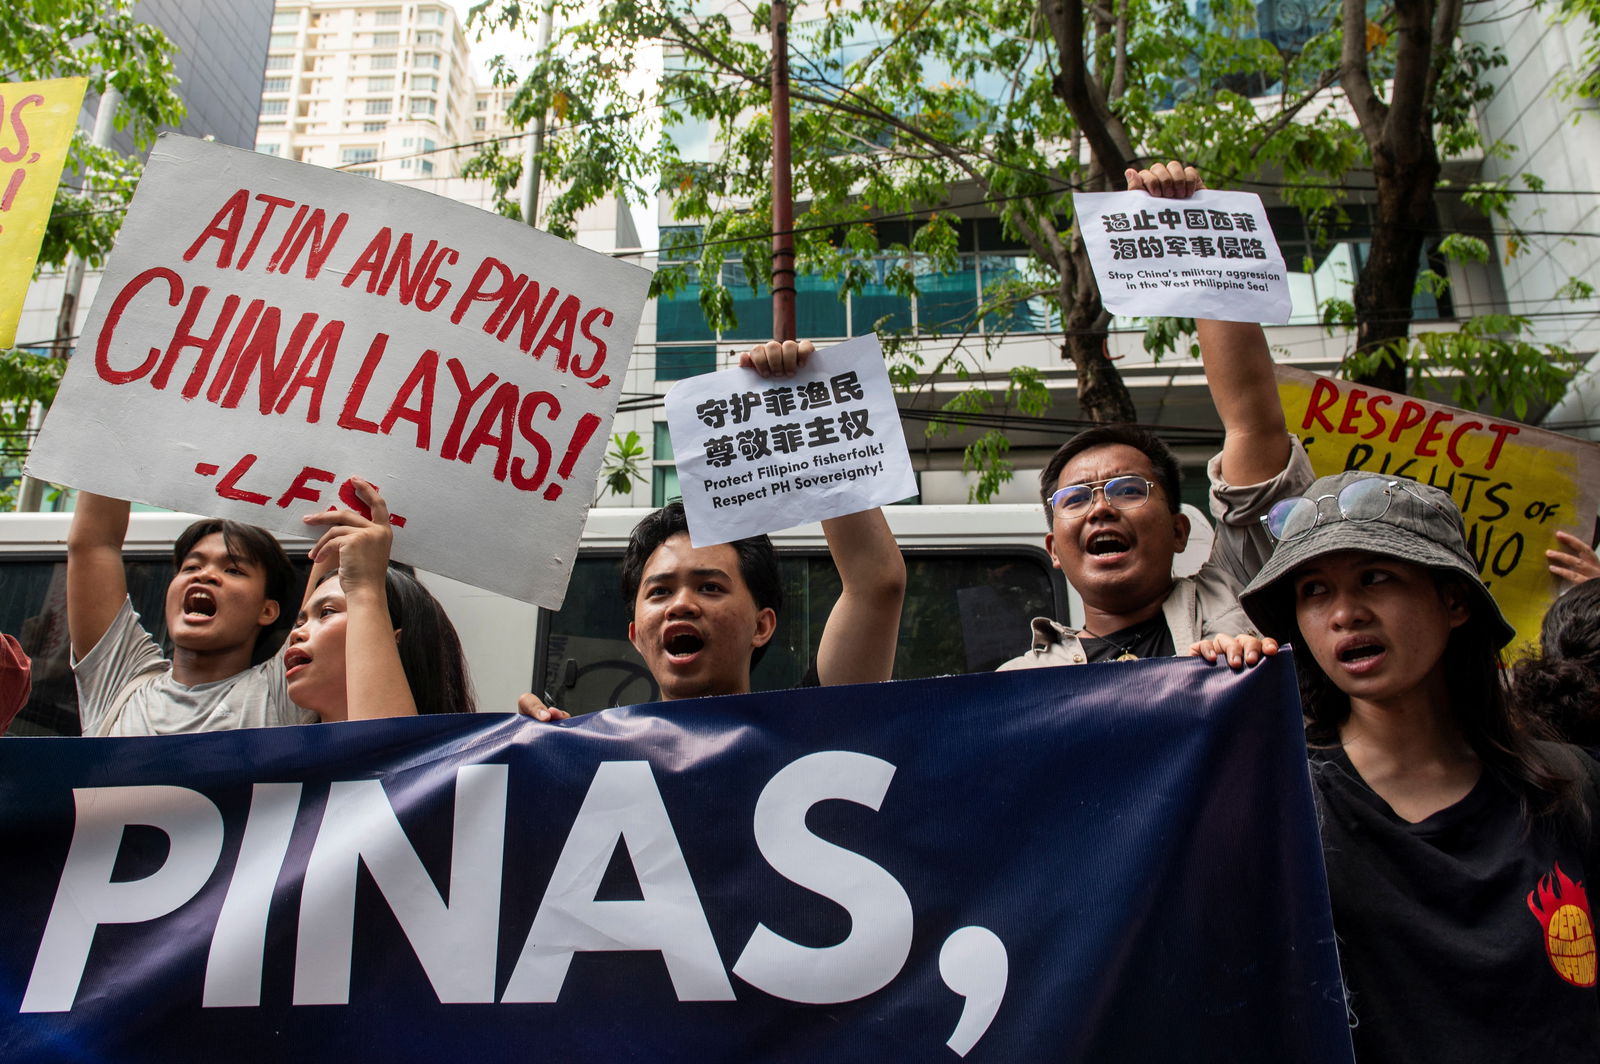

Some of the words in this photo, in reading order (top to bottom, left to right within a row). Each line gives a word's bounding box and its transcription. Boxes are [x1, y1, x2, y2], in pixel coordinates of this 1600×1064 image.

[1101, 208, 1258, 233] 遏止中国西菲
[1109, 236, 1267, 260] 海的军事侵略
[183, 190, 349, 279] ATIN
[342, 227, 460, 313] ANG
[450, 257, 614, 389] PINAS,
[1108, 270, 1134, 281] Stop
[1137, 269, 1179, 280] China's
[1181, 268, 1223, 279] military
[1226, 270, 1281, 282] aggression
[1126, 281, 1137, 290] in
[1140, 280, 1158, 289] the
[1161, 280, 1190, 288] West
[1193, 279, 1245, 292] Philippine
[1247, 281, 1270, 292] Sea!
[95, 267, 345, 424] CHINA
[337, 333, 602, 502] LAYAS!
[696, 370, 864, 429] 守护菲渔民
[703, 408, 875, 468] 尊敬菲主权
[1302, 378, 1521, 470] RESPECT
[703, 471, 753, 492] Protect
[757, 458, 809, 481] Filipino
[812, 443, 885, 466] fisherfolk!
[712, 488, 767, 509] Respect
[771, 479, 791, 496] PH
[795, 460, 884, 489] Sovereignty!
[1523, 499, 1561, 524] OF
[20, 750, 1010, 1058] PINAS,
